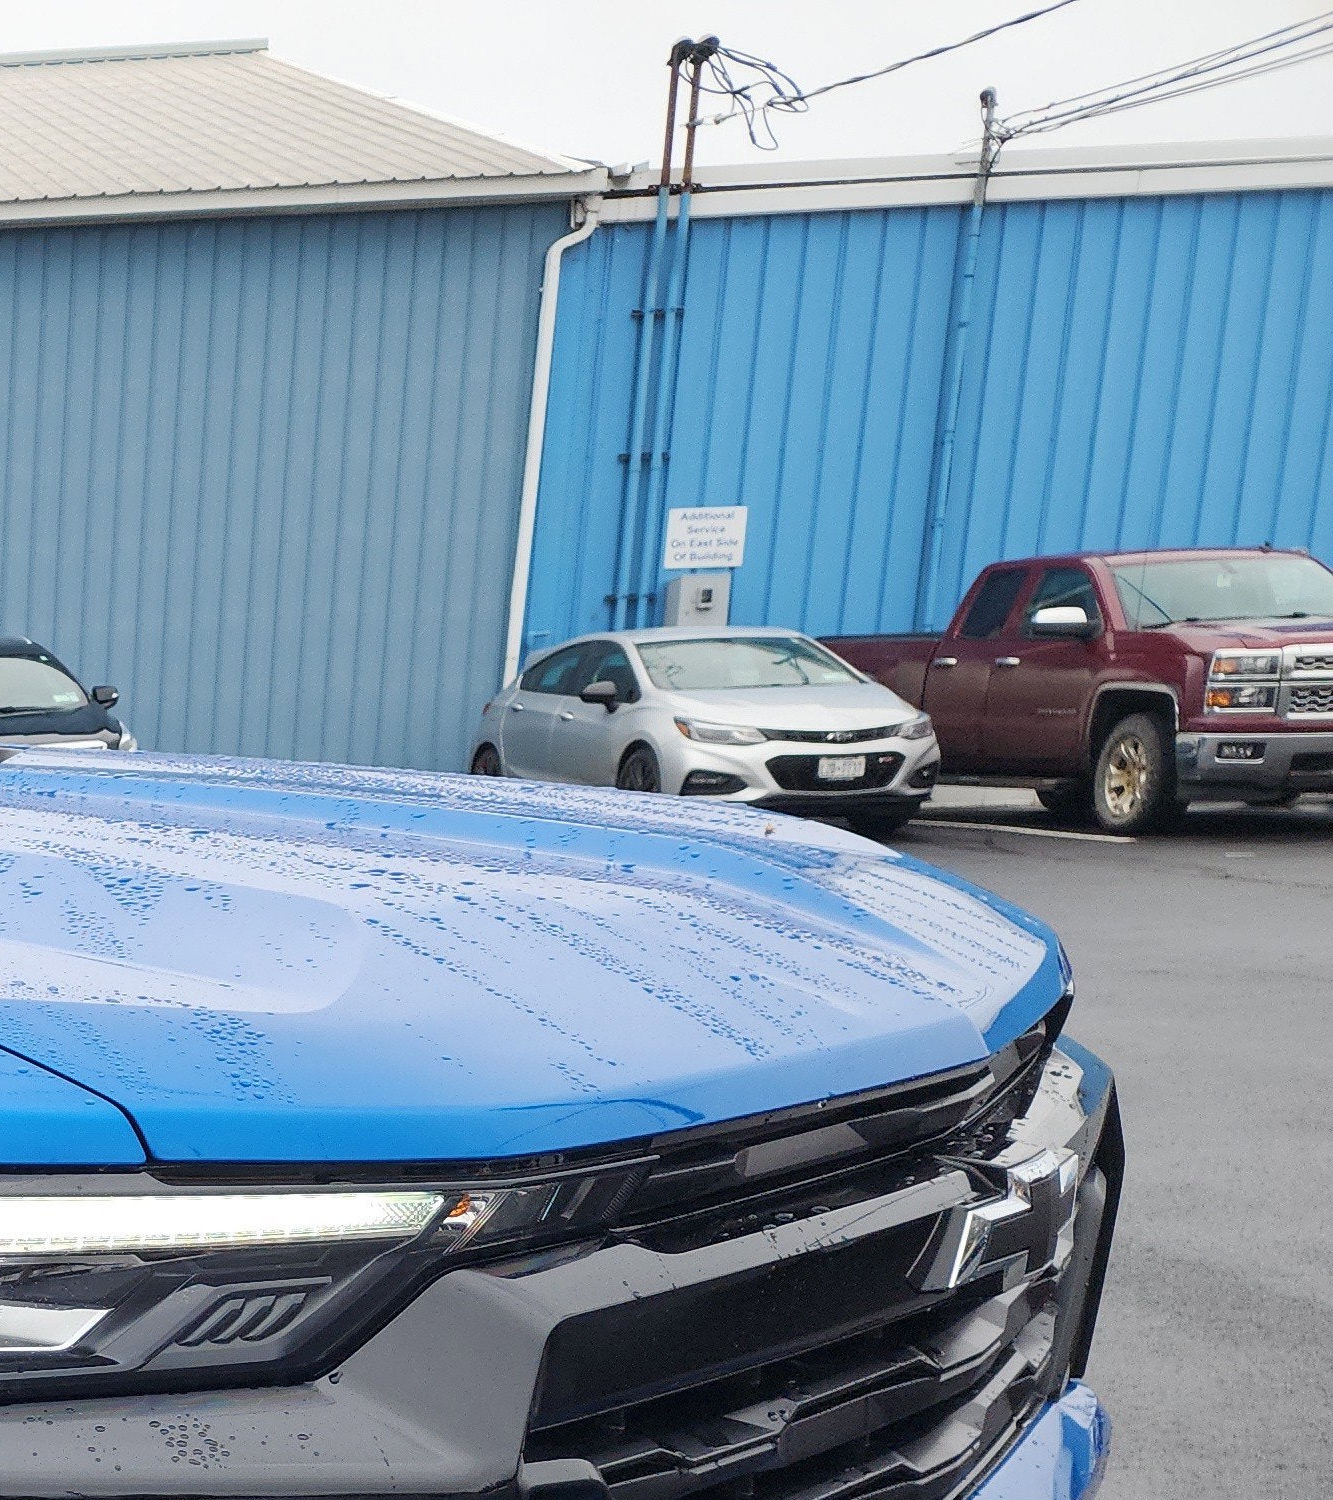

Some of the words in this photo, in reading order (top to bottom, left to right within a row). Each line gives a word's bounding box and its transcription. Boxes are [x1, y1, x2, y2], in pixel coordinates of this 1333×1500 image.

[681, 512, 735, 520] Additional
[687, 525, 726, 534] Service
[690, 551, 734, 563] Building
